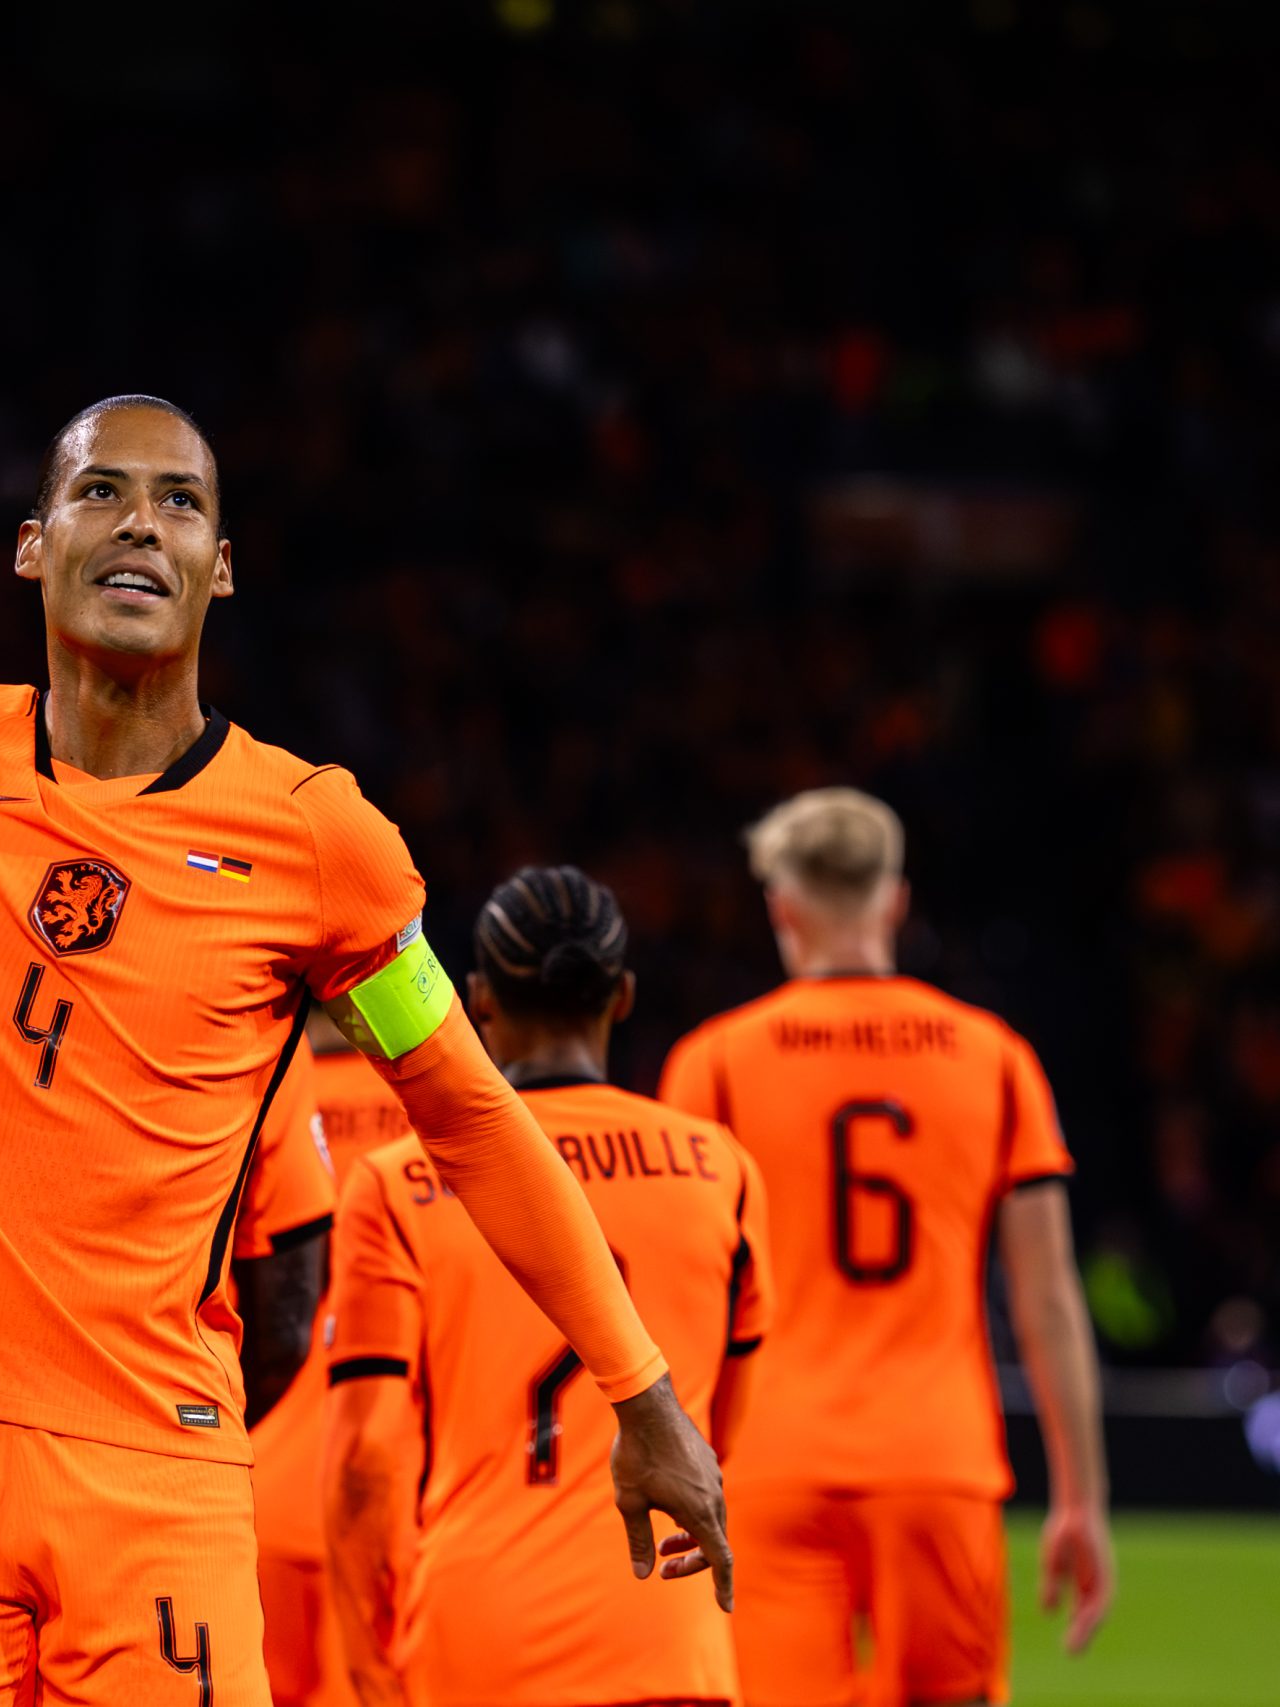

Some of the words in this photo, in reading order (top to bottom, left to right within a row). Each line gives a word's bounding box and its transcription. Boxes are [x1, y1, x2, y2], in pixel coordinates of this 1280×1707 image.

[12, 961, 74, 1089] 4
[403, 1130, 719, 1206] SRVILLE
[828, 1096, 916, 1290] 6
[155, 1596, 214, 1707] 4
